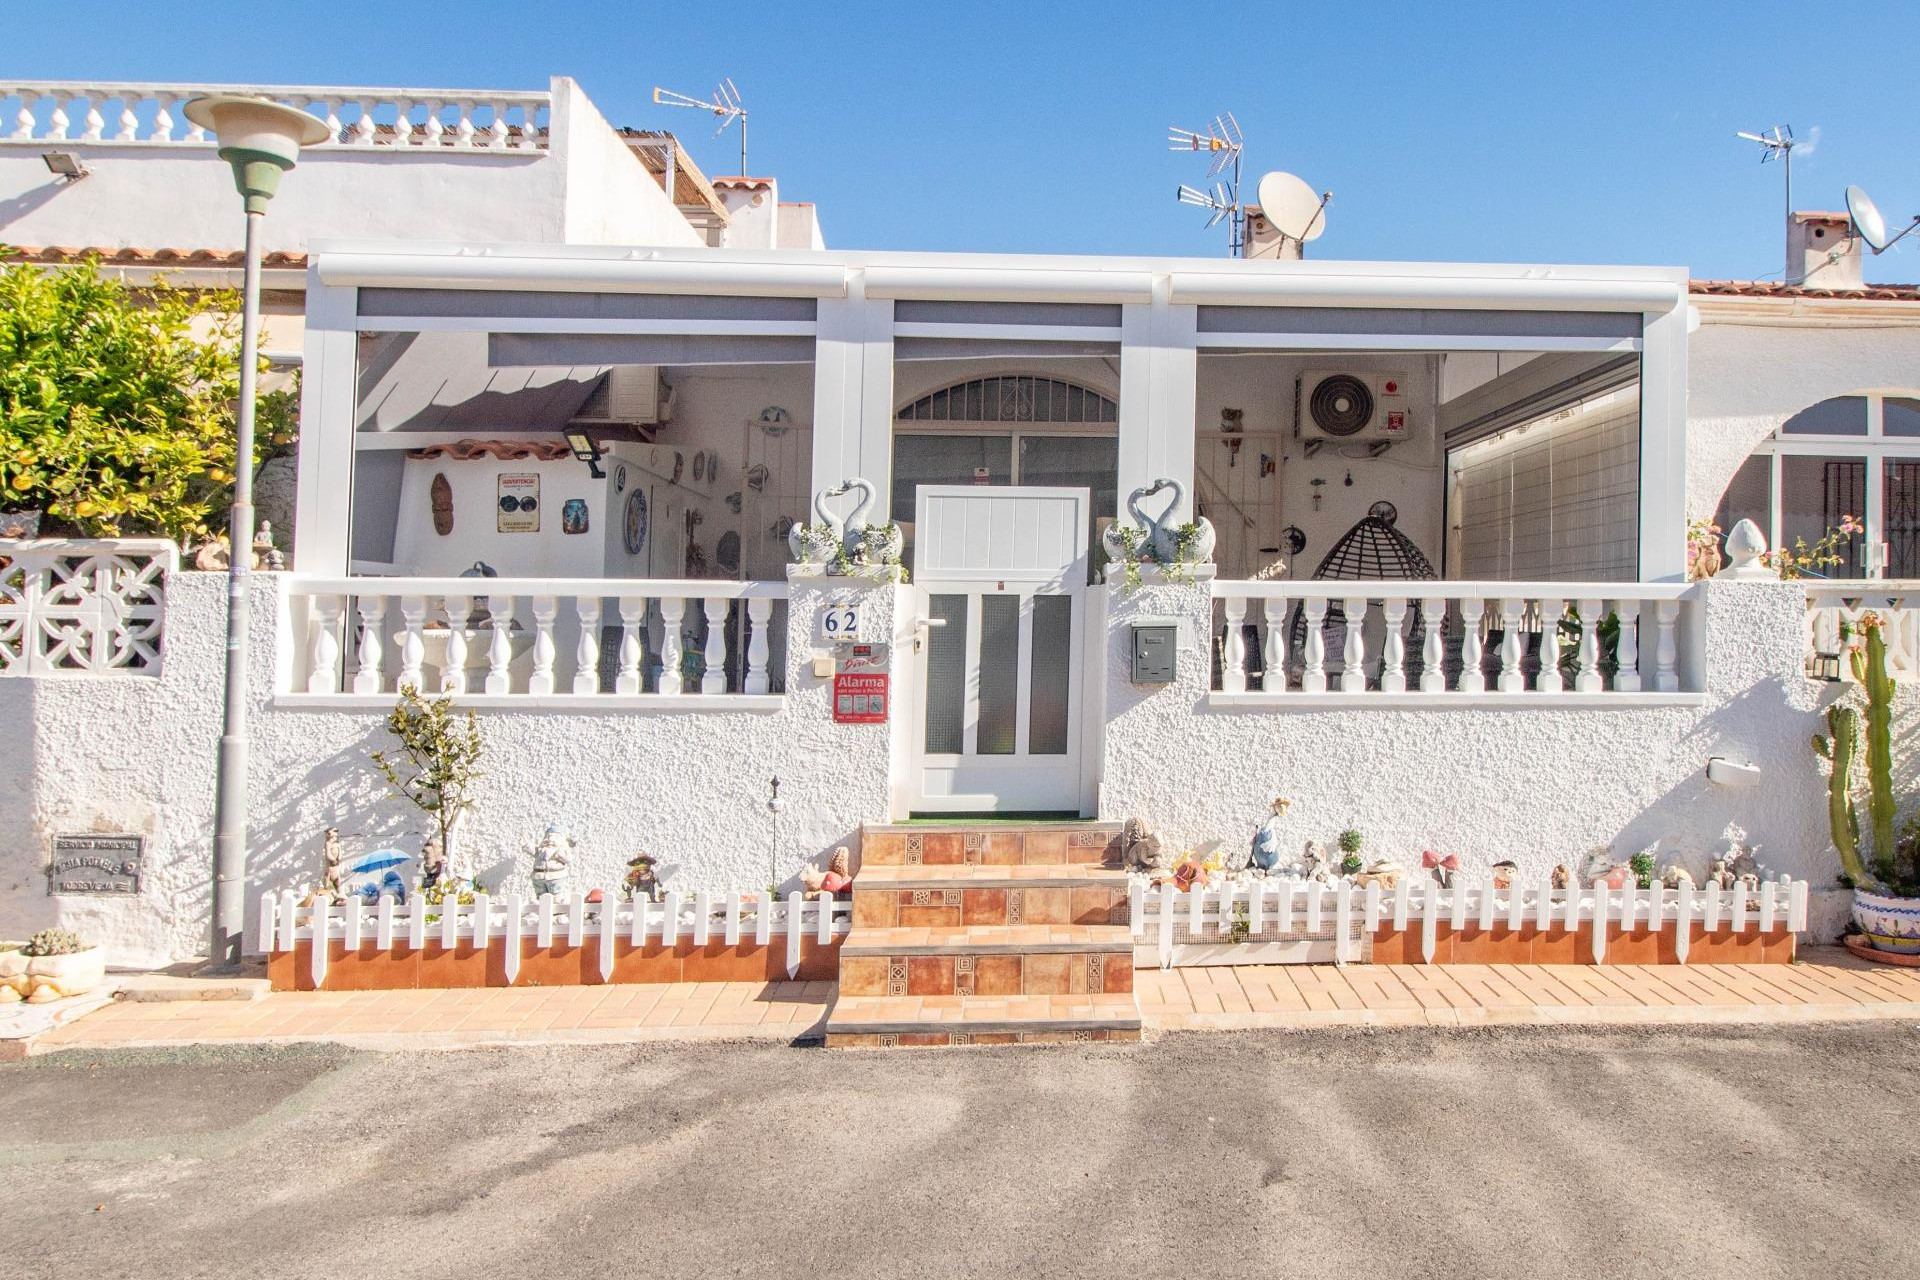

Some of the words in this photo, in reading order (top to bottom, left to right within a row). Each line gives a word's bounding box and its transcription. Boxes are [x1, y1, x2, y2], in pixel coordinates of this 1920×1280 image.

[825, 611, 857, 632] 62
[838, 675, 885, 688] Alarma
[57, 840, 95, 850] SERVICIO
[97, 840, 137, 850] MUNICIPAL
[82, 856, 120, 875] POTABLE
[60, 881, 113, 892] TORREVIEJA
